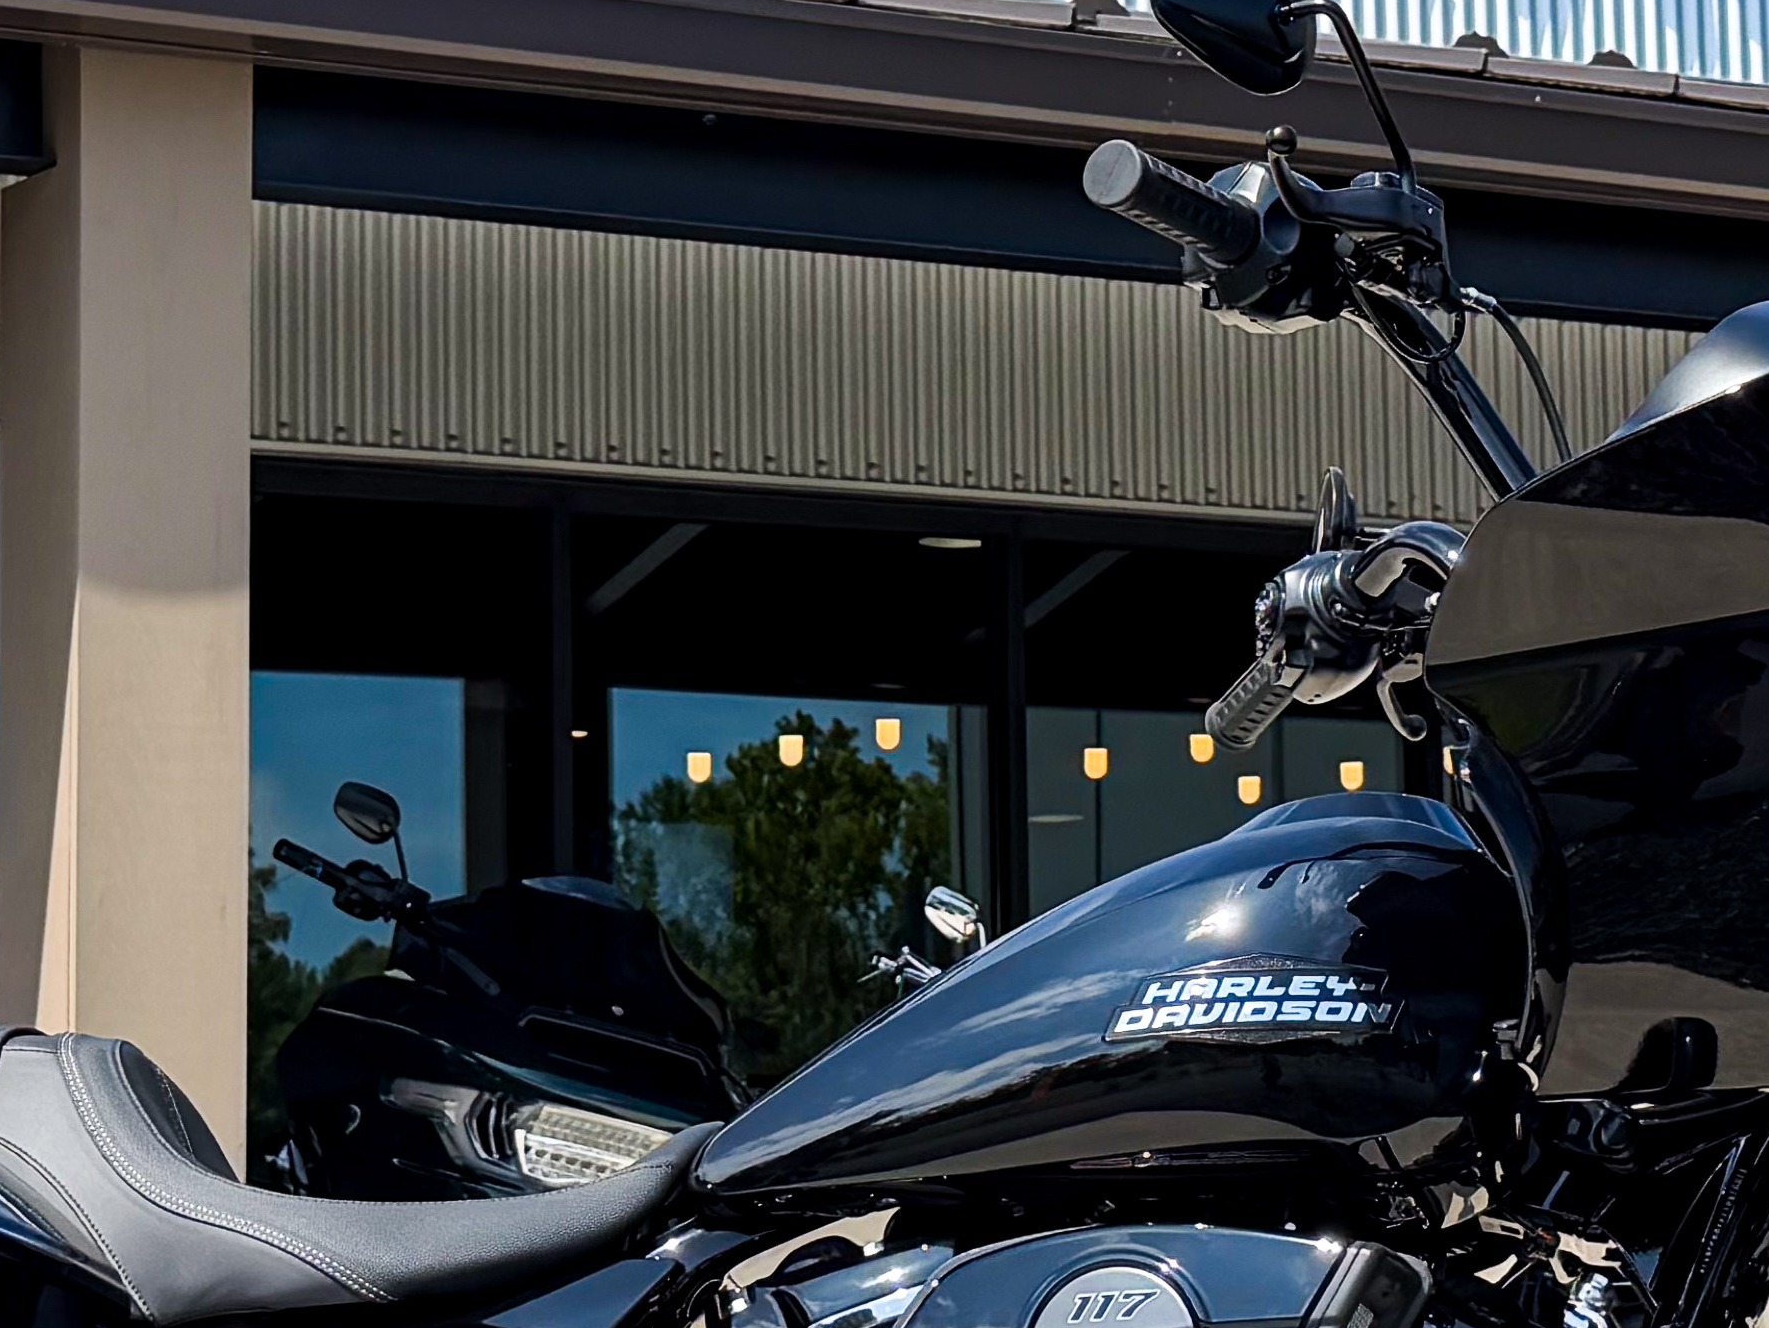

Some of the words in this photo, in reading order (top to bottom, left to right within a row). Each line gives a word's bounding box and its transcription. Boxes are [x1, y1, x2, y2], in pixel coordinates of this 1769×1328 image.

[1142, 975, 1376, 1005] HARLEY-
[1113, 1000, 1392, 1033] DAVIDSON
[1067, 1289, 1161, 1324] 117
